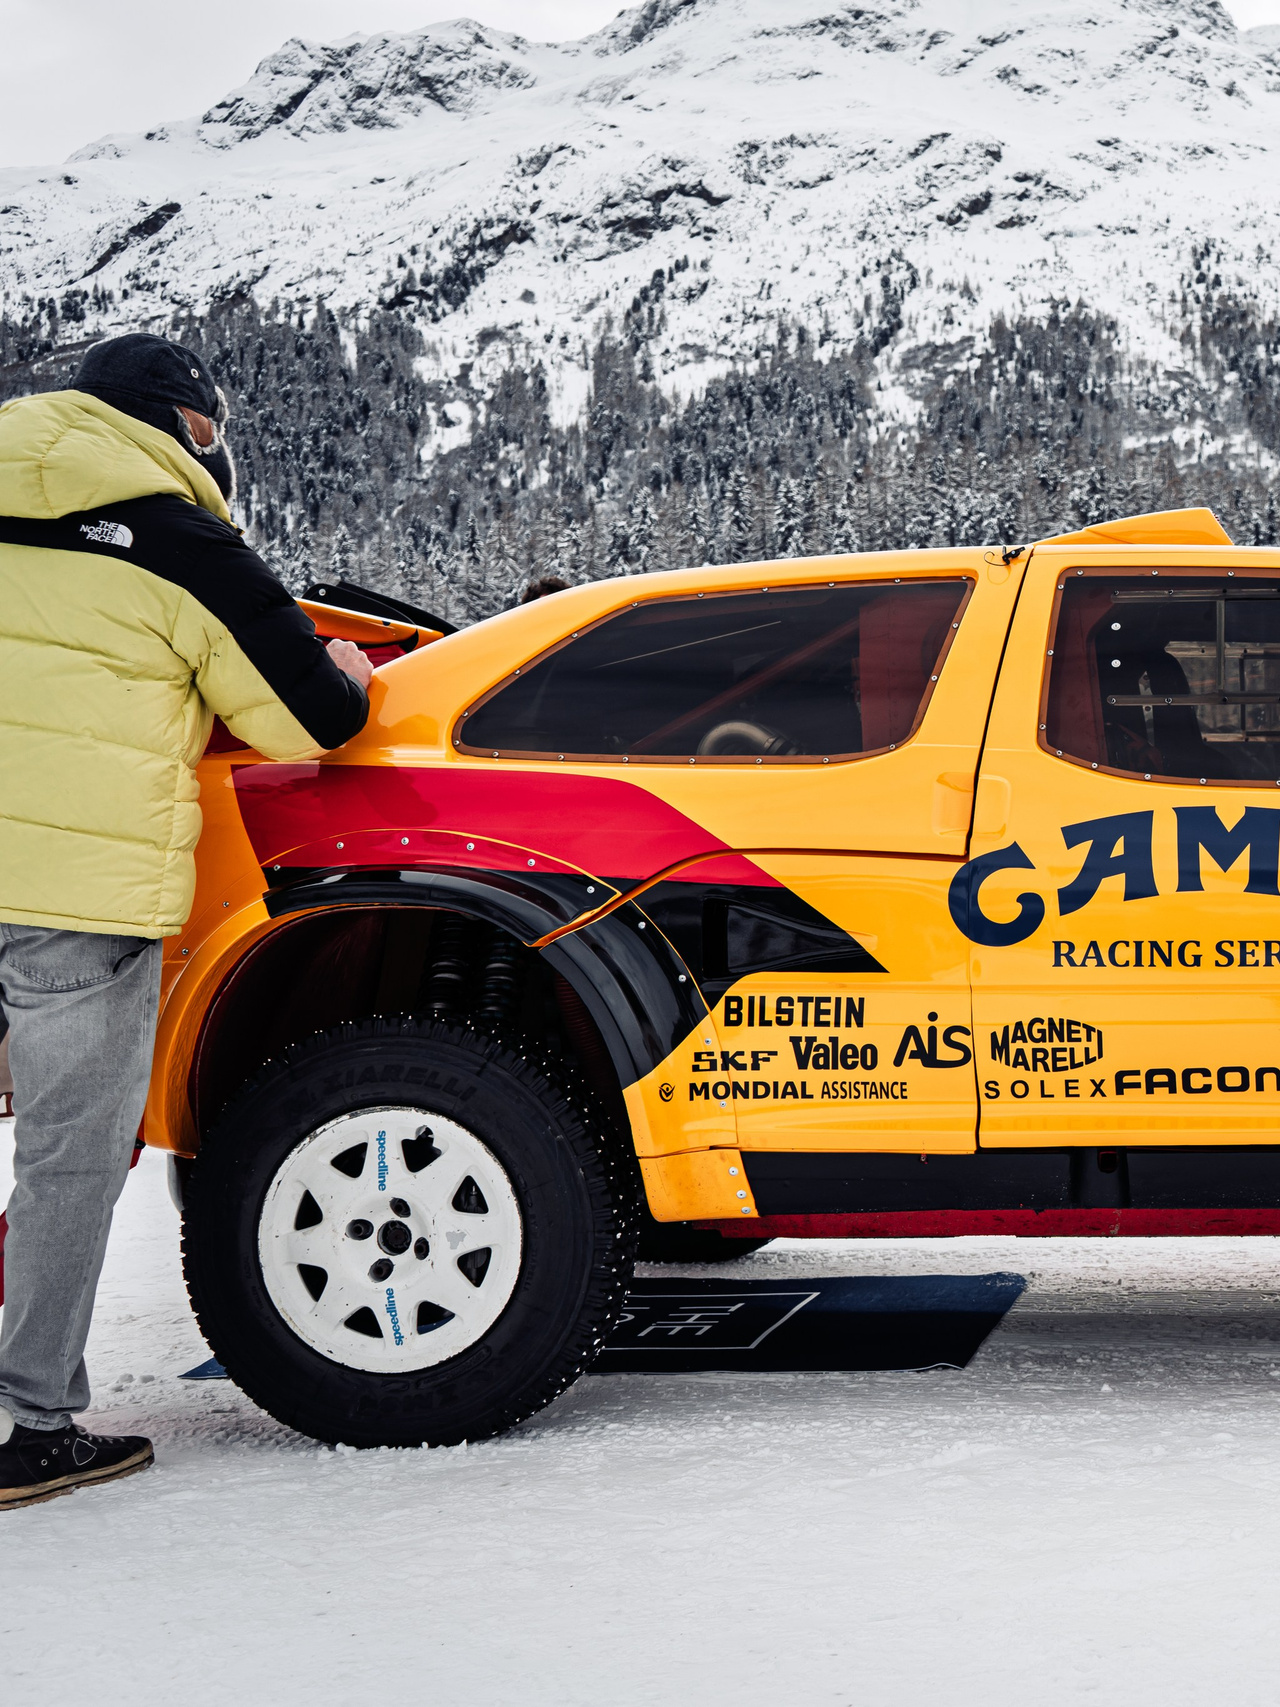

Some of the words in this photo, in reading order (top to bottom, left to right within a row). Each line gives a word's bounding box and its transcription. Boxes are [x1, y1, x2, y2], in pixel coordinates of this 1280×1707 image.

[80, 524, 116, 537] NORTH
[86, 532, 113, 543] FACE
[99, 520, 119, 530] THE
[1052, 939, 1203, 968] RACING
[723, 995, 865, 1028] BILSTEIN
[990, 1017, 1103, 1048] MAGNETI
[691, 1050, 778, 1072] SKF
[789, 1036, 878, 1071] Valeo
[990, 1043, 1103, 1073] MARELLI
[689, 1080, 814, 1101] MONDIAL
[820, 1080, 908, 1100] ASSISTANCE
[984, 1078, 1108, 1100] SOLEX
[376, 1130, 389, 1192] speedline
[385, 1287, 404, 1346] speedline
